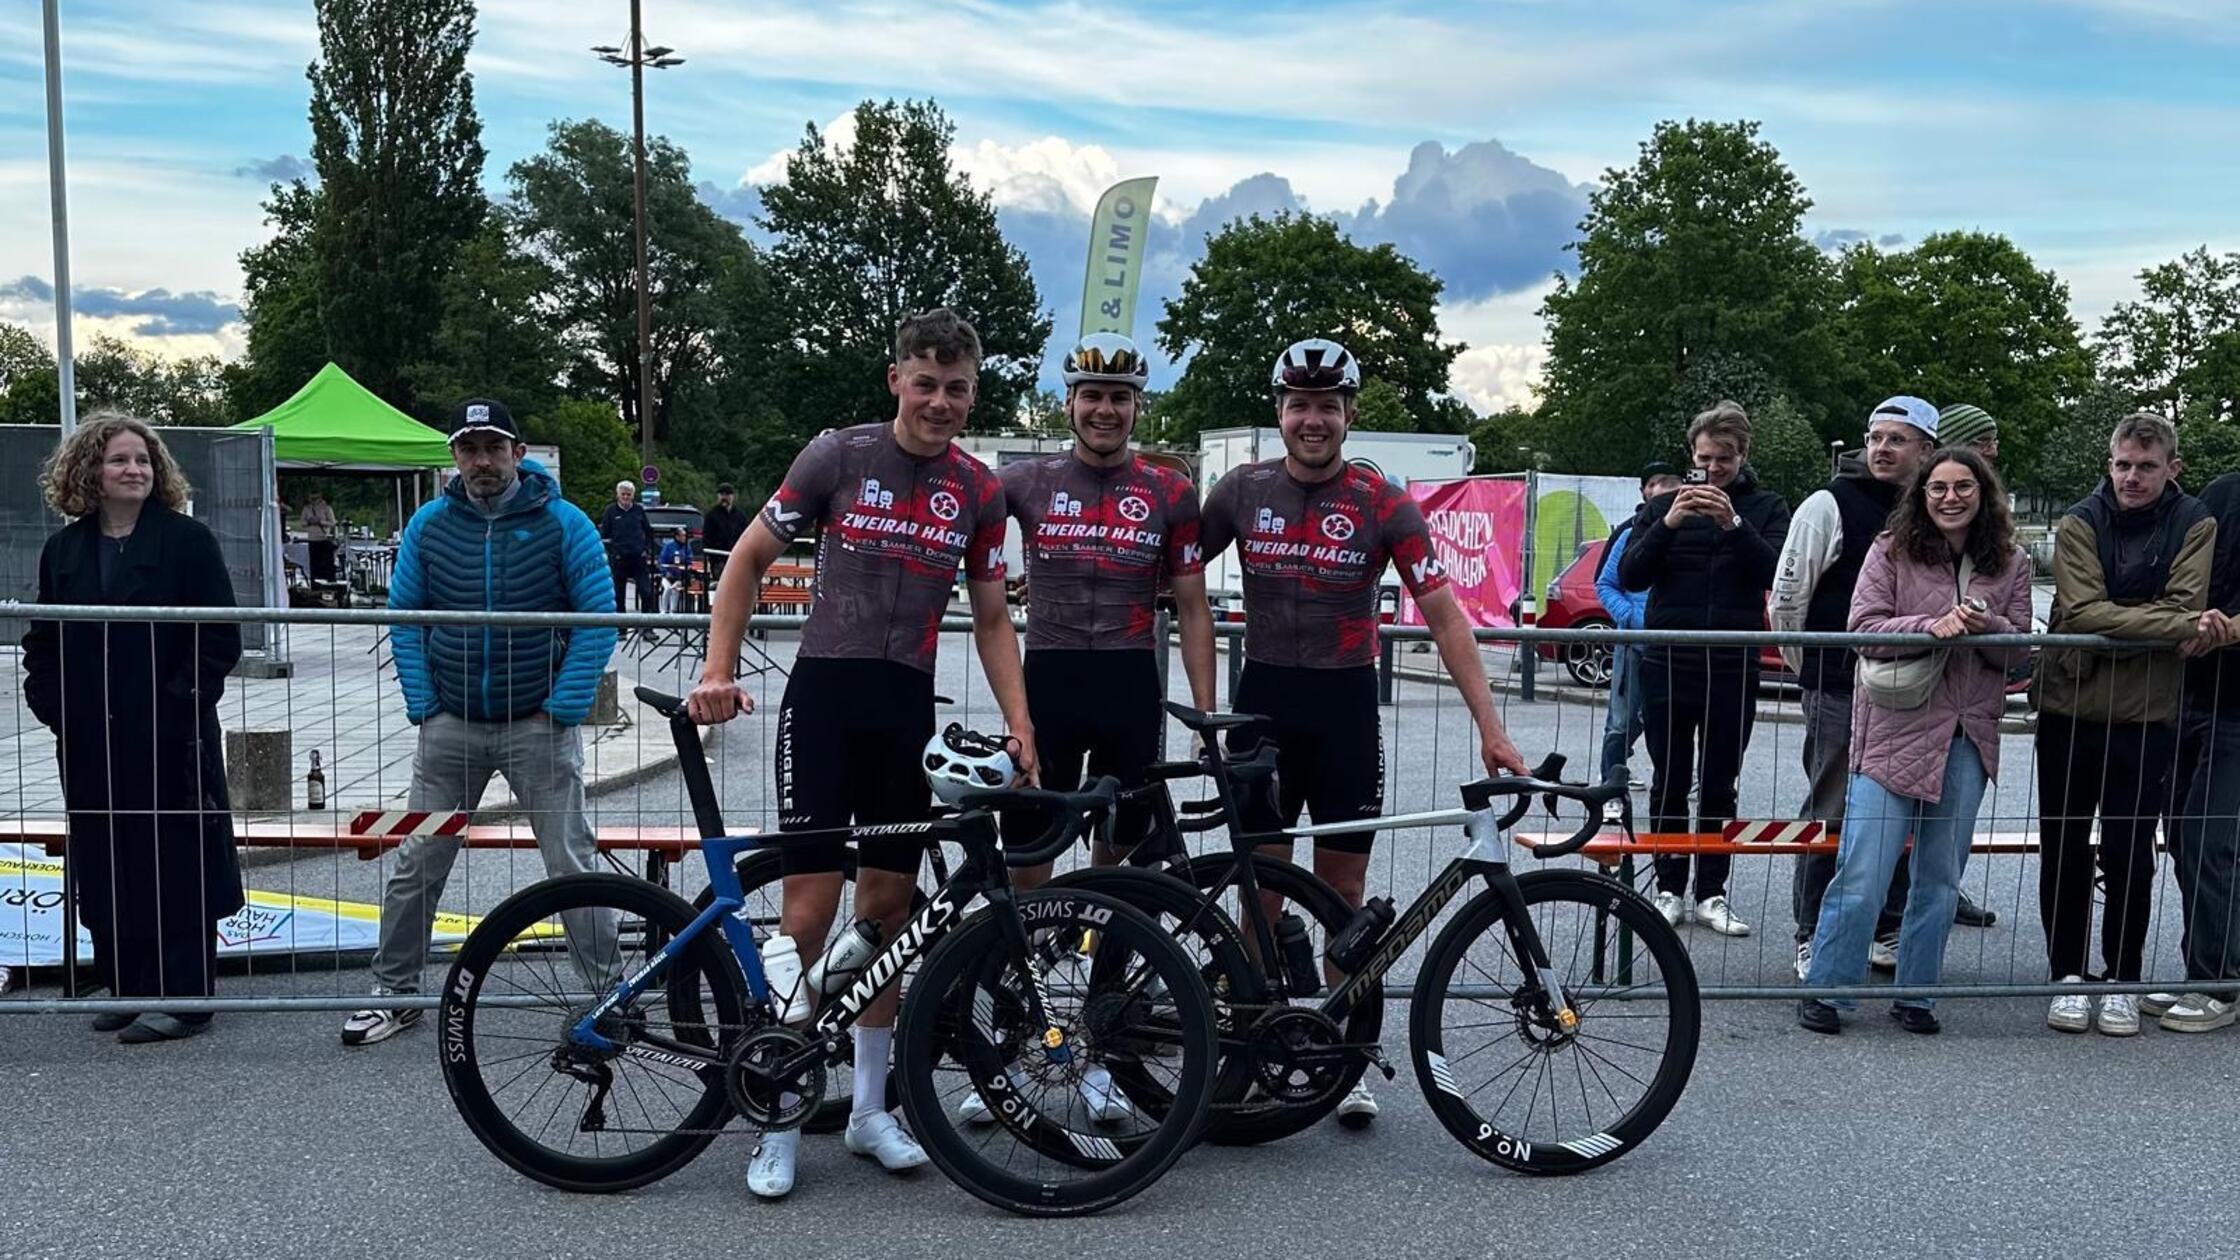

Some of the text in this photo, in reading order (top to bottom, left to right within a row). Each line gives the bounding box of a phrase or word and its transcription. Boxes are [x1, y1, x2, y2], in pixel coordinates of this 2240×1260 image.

[1104, 195, 1135, 288] LIMO
[1101, 298, 1121, 319] &
[841, 513, 968, 548] ZWEIRAD HÄCKL
[1037, 523, 1162, 547] ZWEIRAD HÄCKL
[1244, 539, 1367, 564] ZWEIRAD HÄCKL
[783, 708, 793, 810] KLINGELE
[849, 822, 932, 837] SPECIALIZED
[239, 909, 276, 923] HAU
[1017, 901, 1114, 925] DT SWISS
[816, 888, 954, 1033] S-WORKS
[448, 967, 475, 1063] DT SWISS
[625, 1045, 708, 1071] SPECIALIZED
